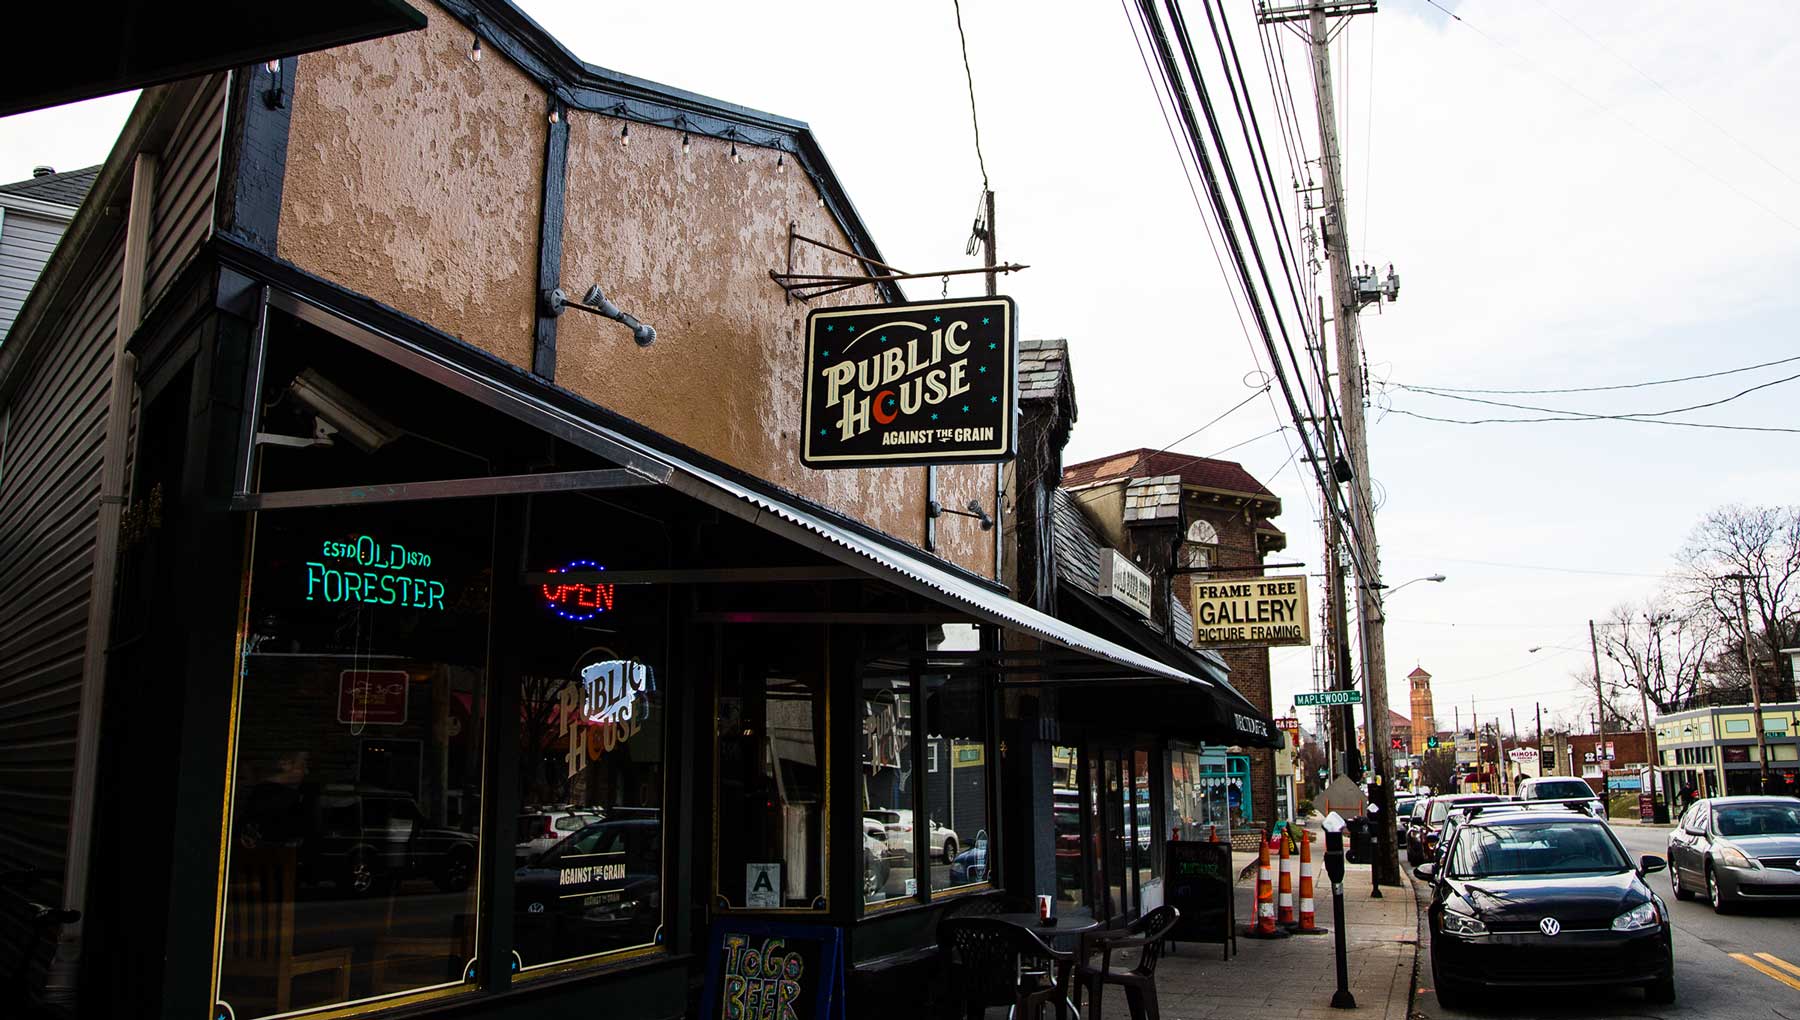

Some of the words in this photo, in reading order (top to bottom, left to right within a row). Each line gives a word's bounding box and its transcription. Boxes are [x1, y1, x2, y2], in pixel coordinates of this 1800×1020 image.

[822, 320, 971, 408] PUBLIC
[836, 358, 971, 442] HOUSE
[882, 430, 934, 445] AGAINST
[936, 428, 953, 438] THE
[955, 427, 994, 442] GRAIN
[357, 535, 405, 569] OLD
[306, 562, 445, 610] FORESTER
[543, 569, 613, 611] OPEN
[1199, 585, 1252, 599] FRAME
[1257, 582, 1297, 596] TREE
[1199, 598, 1298, 625] GALLERY
[1197, 627, 1245, 640] PICTURE
[1250, 625, 1301, 640] FRAMING
[558, 656, 642, 738] PUBLIC
[1297, 692, 1349, 705] MAPLEWOOD
[559, 867, 593, 886] AGAINST
[593, 865, 603, 876] THE
[603, 863, 626, 881] GRAIN
[752, 871, 773, 892] A
[721, 975, 802, 1020] BEER
